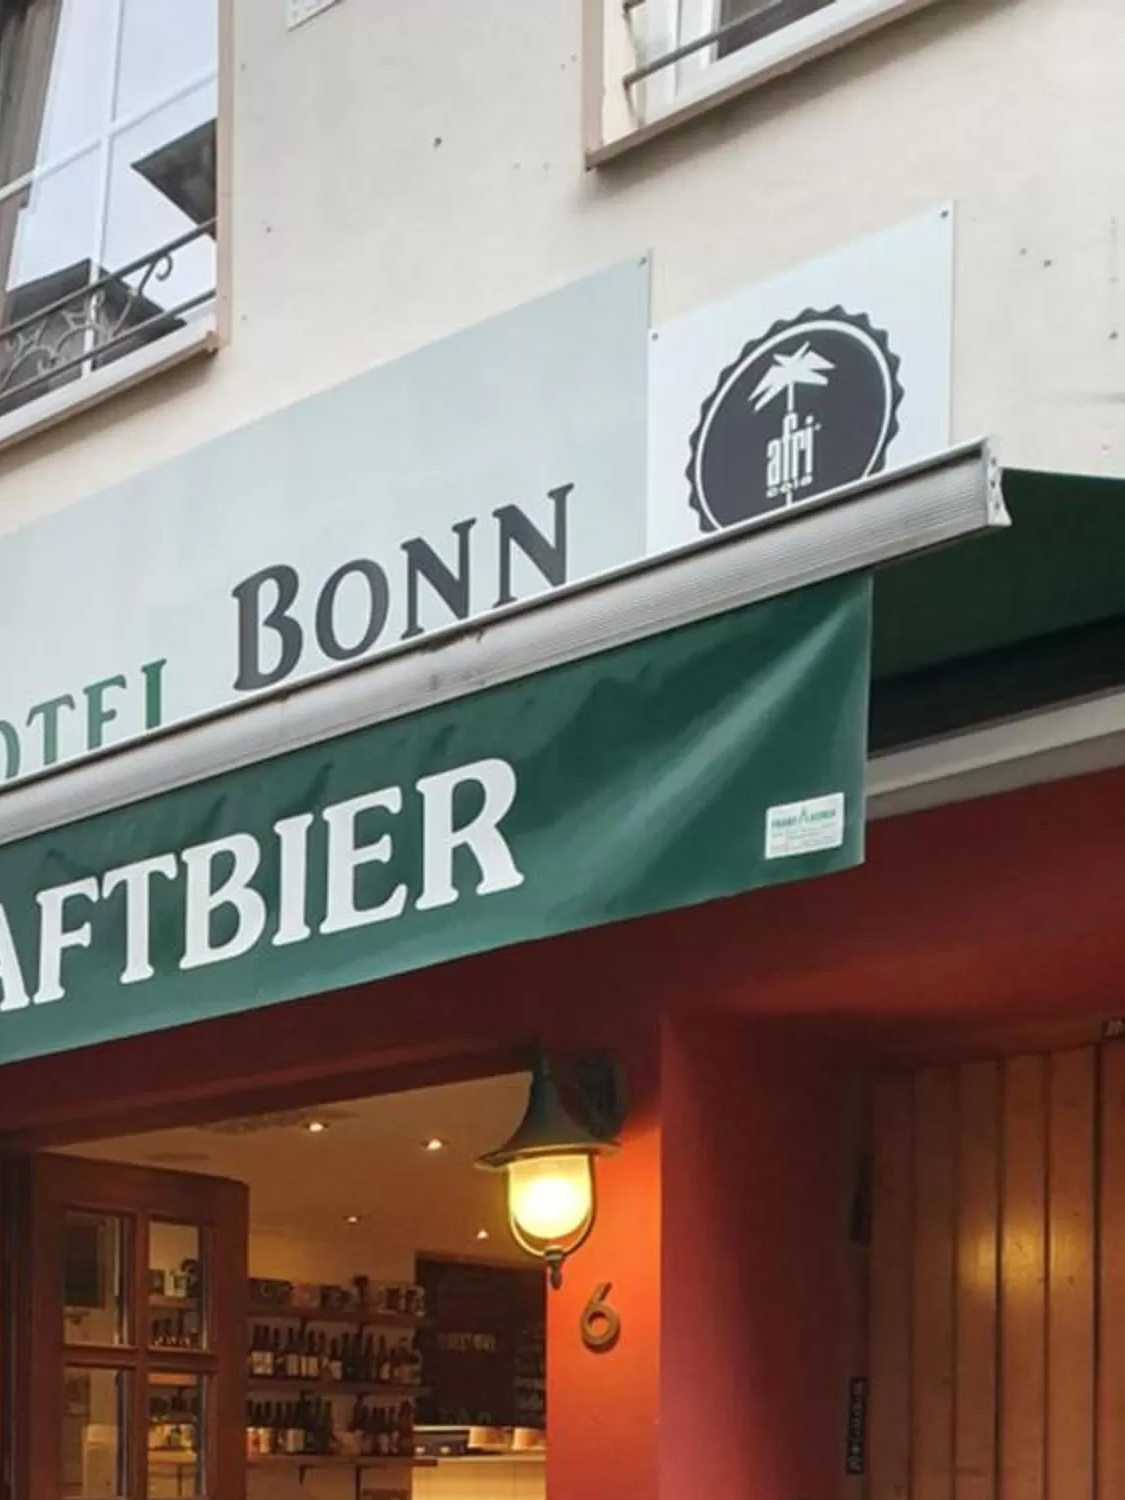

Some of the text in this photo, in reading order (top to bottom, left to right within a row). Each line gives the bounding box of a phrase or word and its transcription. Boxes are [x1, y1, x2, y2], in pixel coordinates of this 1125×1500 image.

[767, 412, 814, 487] afri
[231, 483, 574, 692] BONN
[580, 1282, 621, 1352] 6
